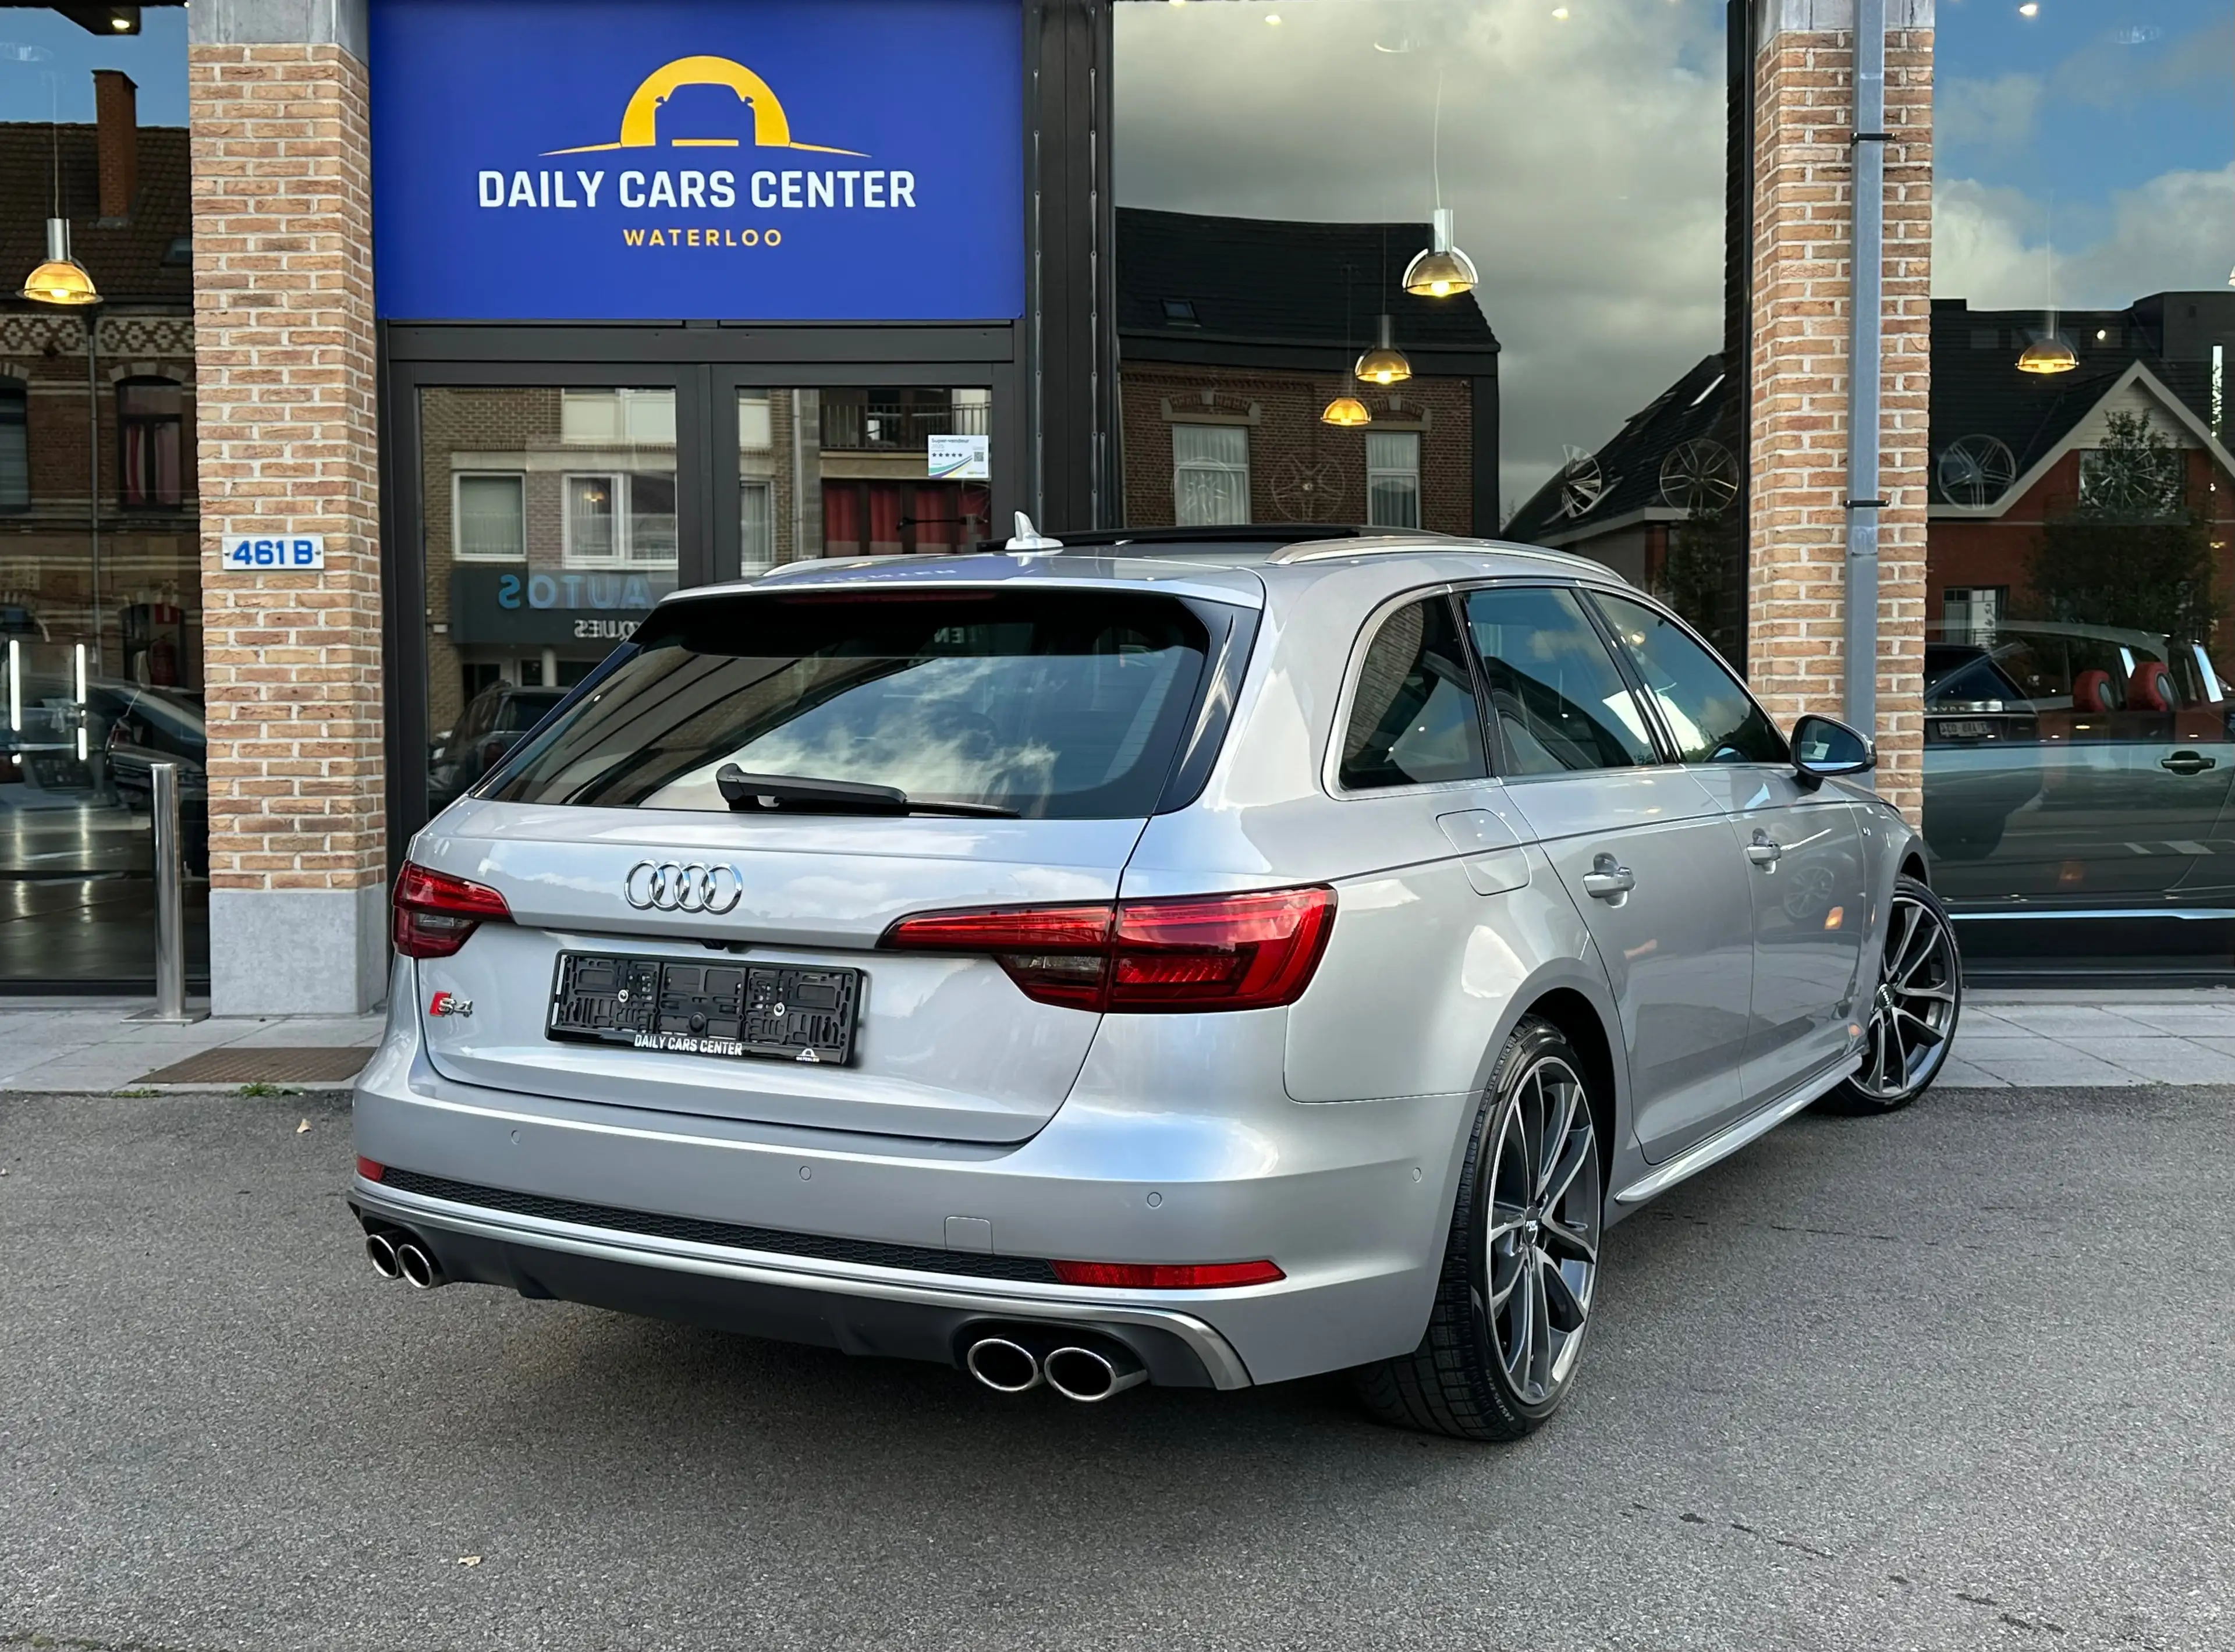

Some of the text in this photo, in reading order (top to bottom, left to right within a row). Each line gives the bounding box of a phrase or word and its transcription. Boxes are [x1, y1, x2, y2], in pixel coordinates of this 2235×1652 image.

[478, 170, 917, 208] DAILY CARS CENTER
[623, 229, 782, 247] WATERLOO
[232, 539, 313, 565] 461 B
[633, 1034, 743, 1056] DAILY CARS CENTER
